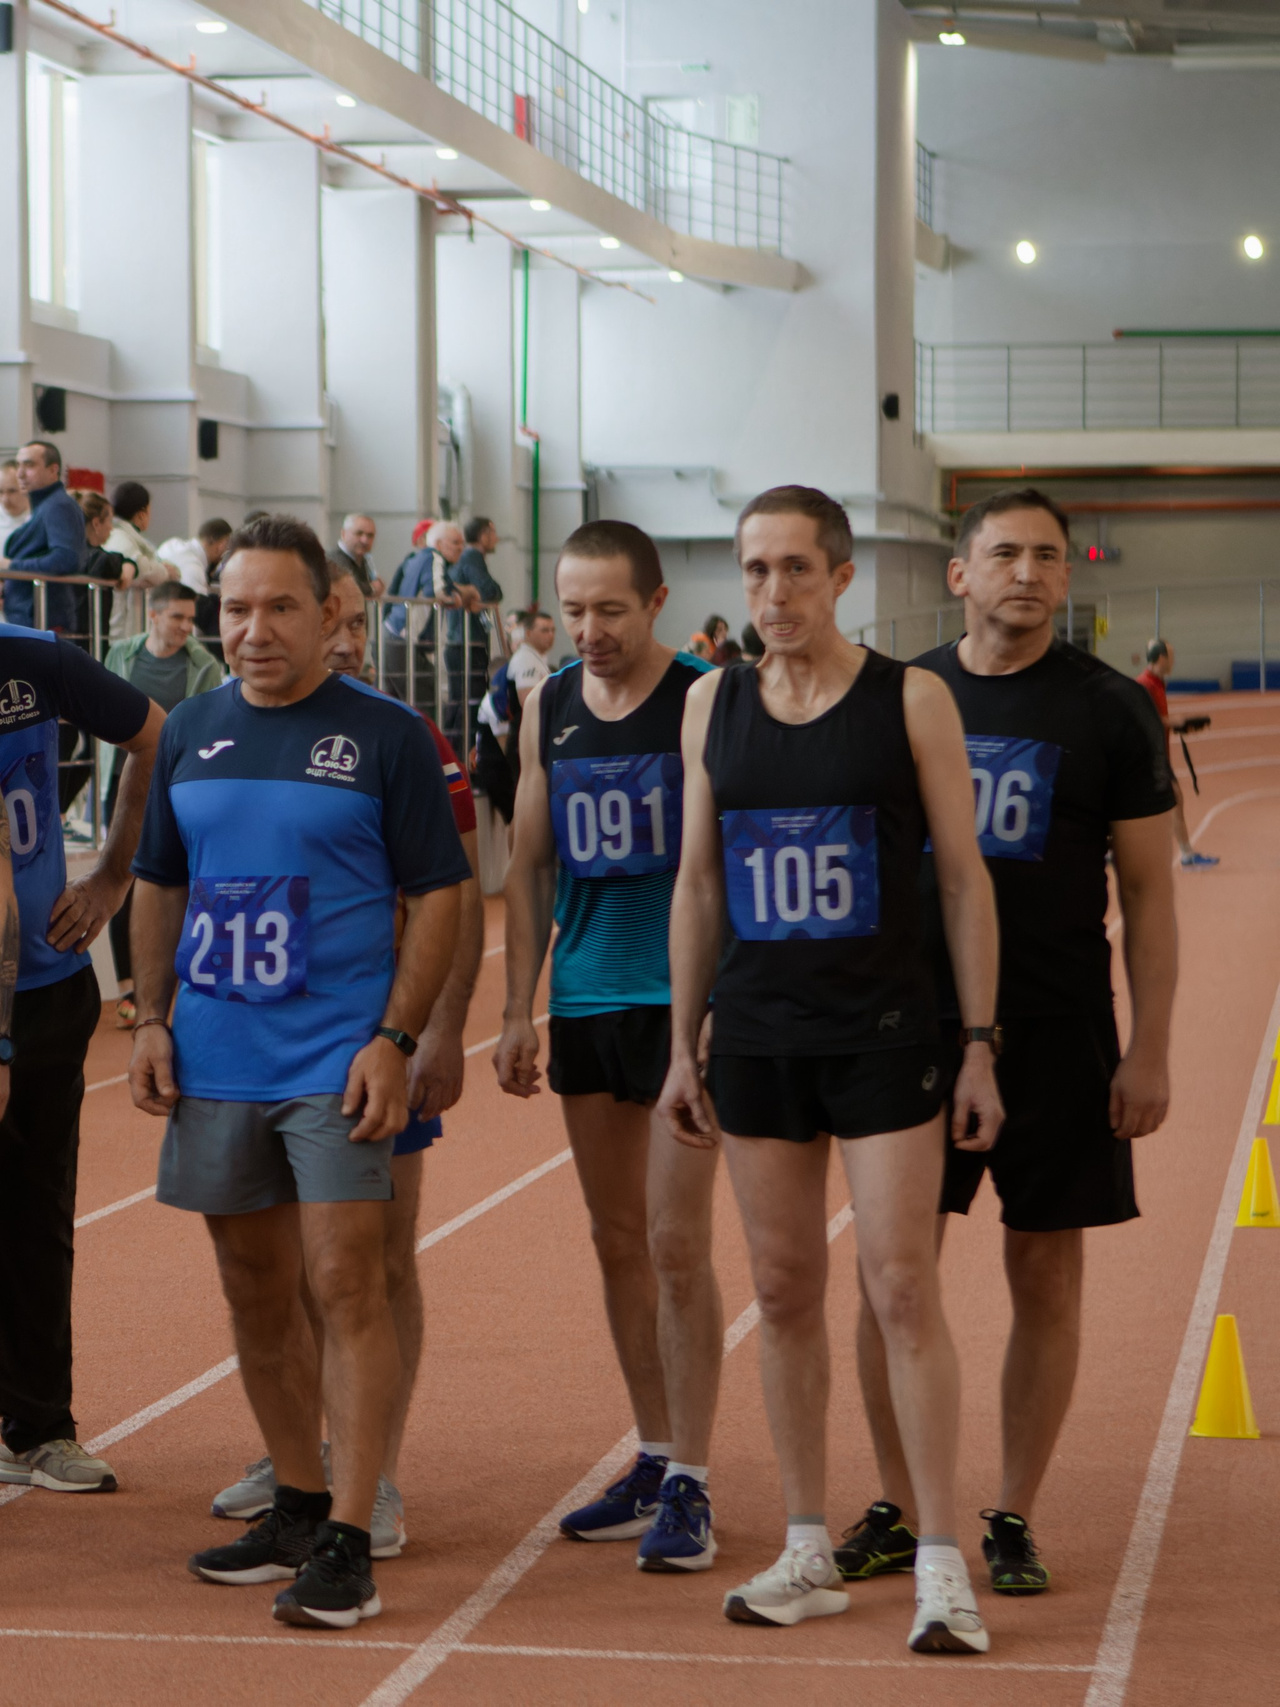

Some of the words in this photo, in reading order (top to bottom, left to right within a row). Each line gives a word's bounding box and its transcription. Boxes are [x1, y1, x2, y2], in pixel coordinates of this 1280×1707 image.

[566, 786, 666, 862] 091
[744, 844, 853, 923] 105
[189, 911, 289, 986] 213
